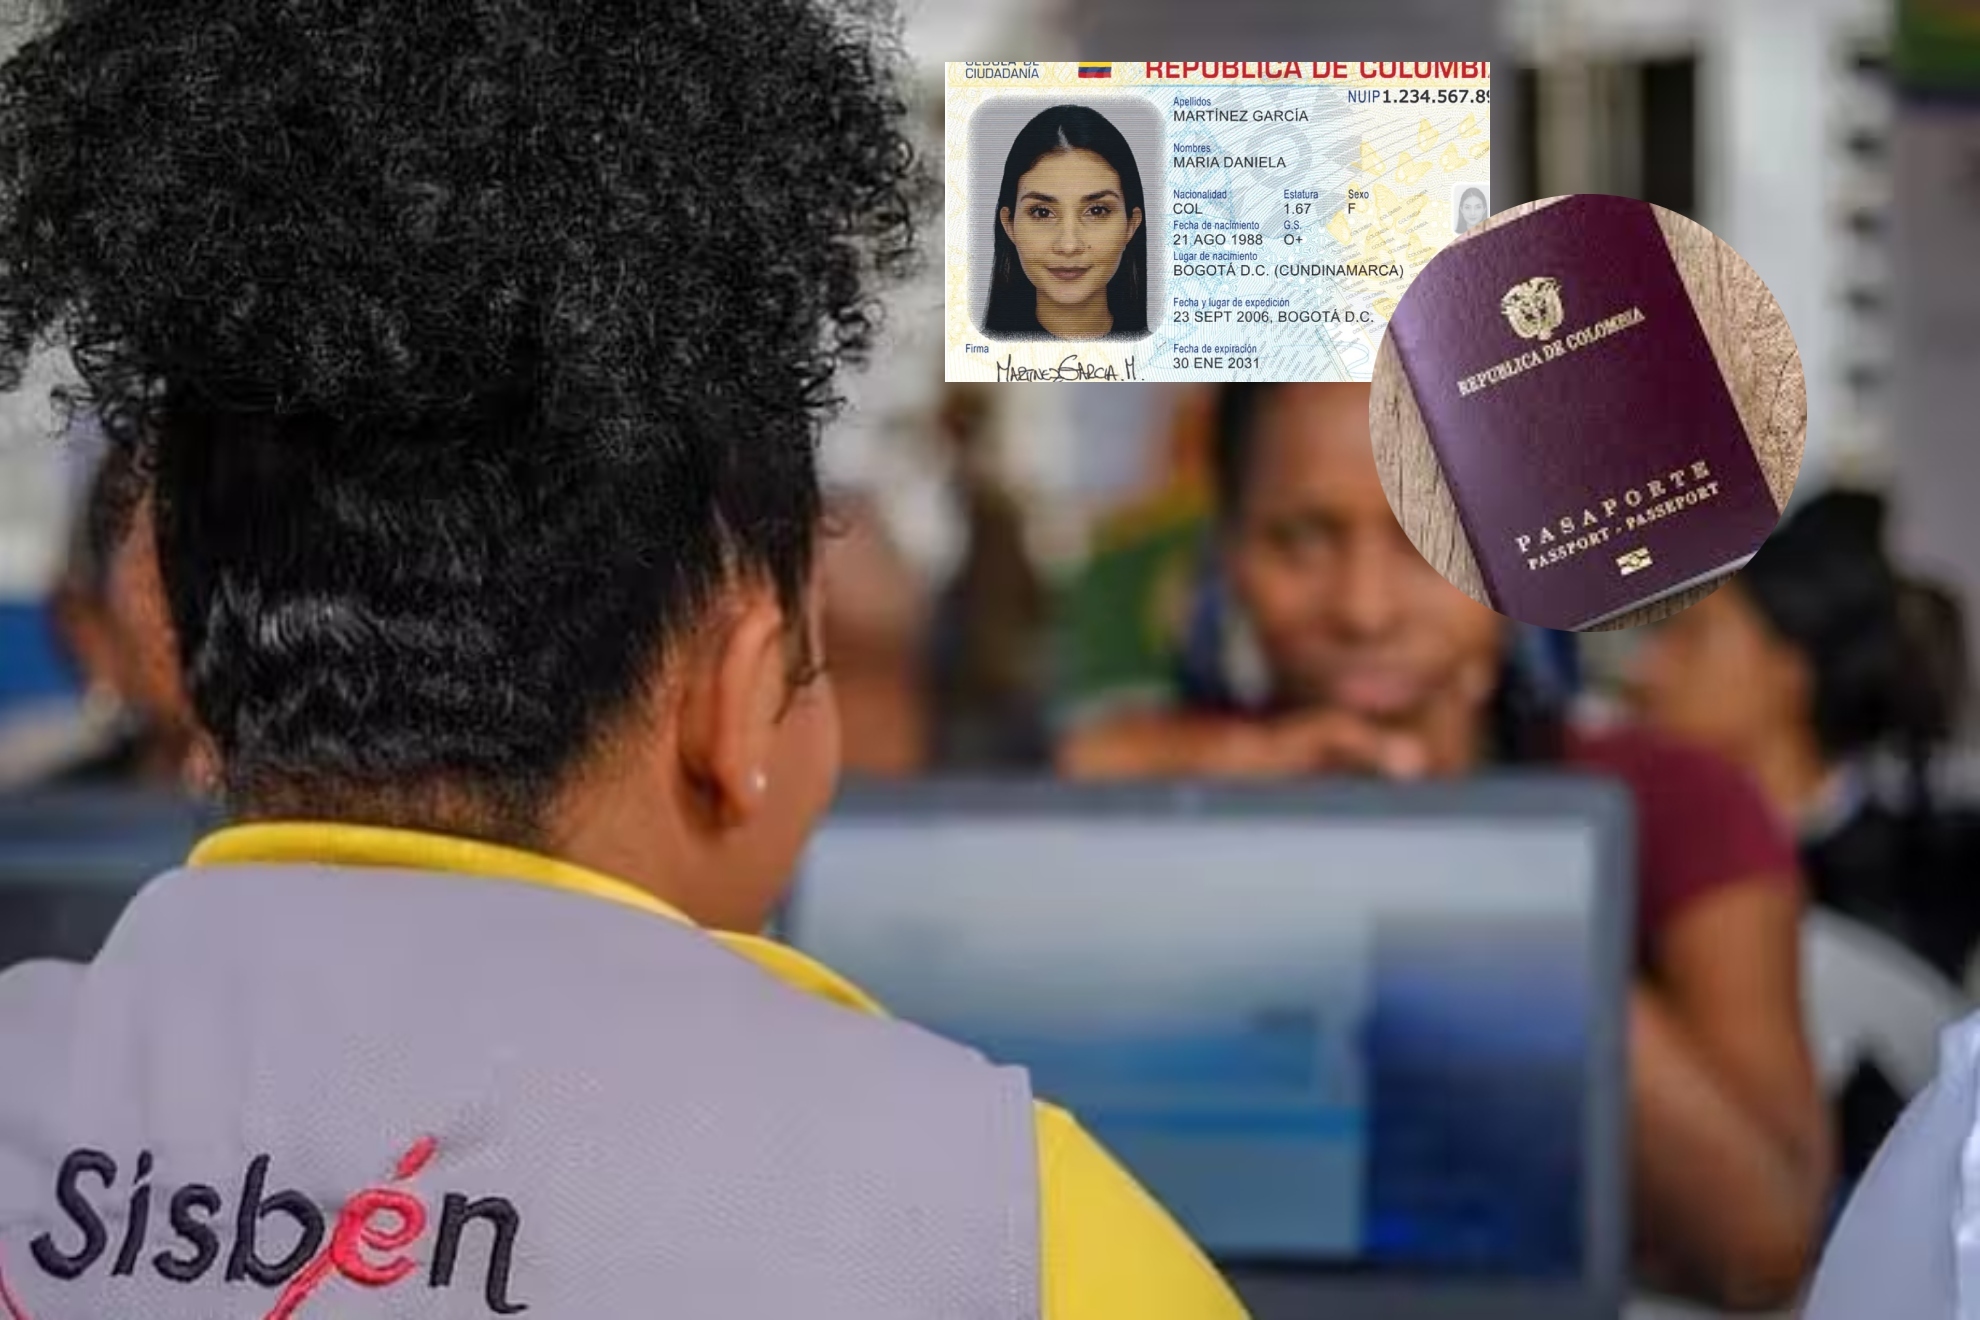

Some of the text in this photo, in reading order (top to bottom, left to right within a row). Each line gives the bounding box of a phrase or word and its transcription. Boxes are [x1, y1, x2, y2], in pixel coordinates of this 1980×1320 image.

[965, 66, 1039, 78] CIUDADANÍA
[1312, 62, 1347, 79] DE
[1360, 62, 1490, 79] COLOMBI
[1173, 97, 1211, 107] Apellidos
[1348, 90, 1380, 103] NUIP
[1173, 108, 1309, 122] MARTÍNEZ GARCÍA
[1173, 143, 1211, 153] Nombres
[1173, 156, 1286, 168] MARIA DANIELA
[1173, 189, 1227, 200] Nacionalidad
[1284, 189, 1319, 200] Estatura
[1348, 189, 1370, 200] Sexo
[1173, 203, 1203, 215] COL
[1284, 203, 1311, 215] 1.67
[1348, 203, 1356, 214] F
[1173, 219, 1260, 231] Fecha de nacimiento
[1284, 220, 1302, 230] G.S.
[1173, 233, 1263, 246] 21 AGO 1988
[1284, 233, 1303, 246] O+
[1173, 251, 1258, 262] Lugar de nacimiento
[1173, 262, 1237, 277] BOGOTÁ
[1240, 264, 1270, 277] D.C.
[1274, 264, 1404, 278] (CUNDINAMARCA)
[1173, 297, 1290, 309] Fecha y lugar de expedición
[1173, 309, 1374, 324] 23 SEPT 2006, BOGOTÁ D.C.
[965, 343, 989, 353] Firma
[1173, 343, 1257, 355] Fecha de expiración
[1457, 306, 1646, 396] REPUBLICA DE COLOMBIA
[1173, 357, 1260, 369] 30 ENE 2031
[1515, 460, 1710, 553] PASAPORTE
[1527, 527, 1610, 570] PASSPORT
[1626, 482, 1720, 530] PASSEPORT
[29, 1135, 528, 1314] Sisbén
